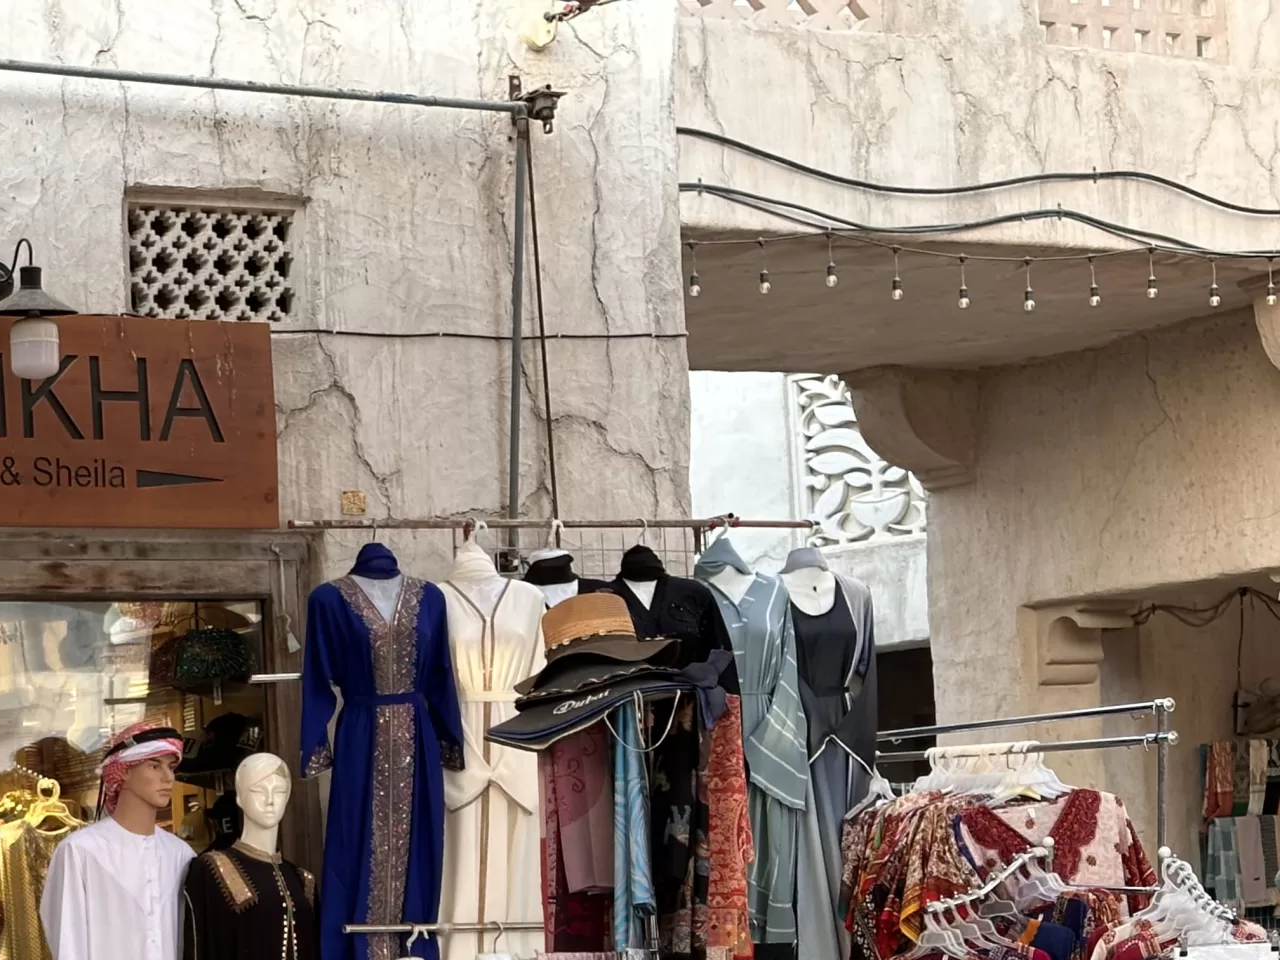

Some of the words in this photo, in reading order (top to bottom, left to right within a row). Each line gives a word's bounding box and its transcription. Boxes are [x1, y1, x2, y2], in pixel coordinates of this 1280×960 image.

[0, 457, 22, 486] &
[32, 457, 125, 489] Sheila
[553, 689, 611, 715] Dubai
